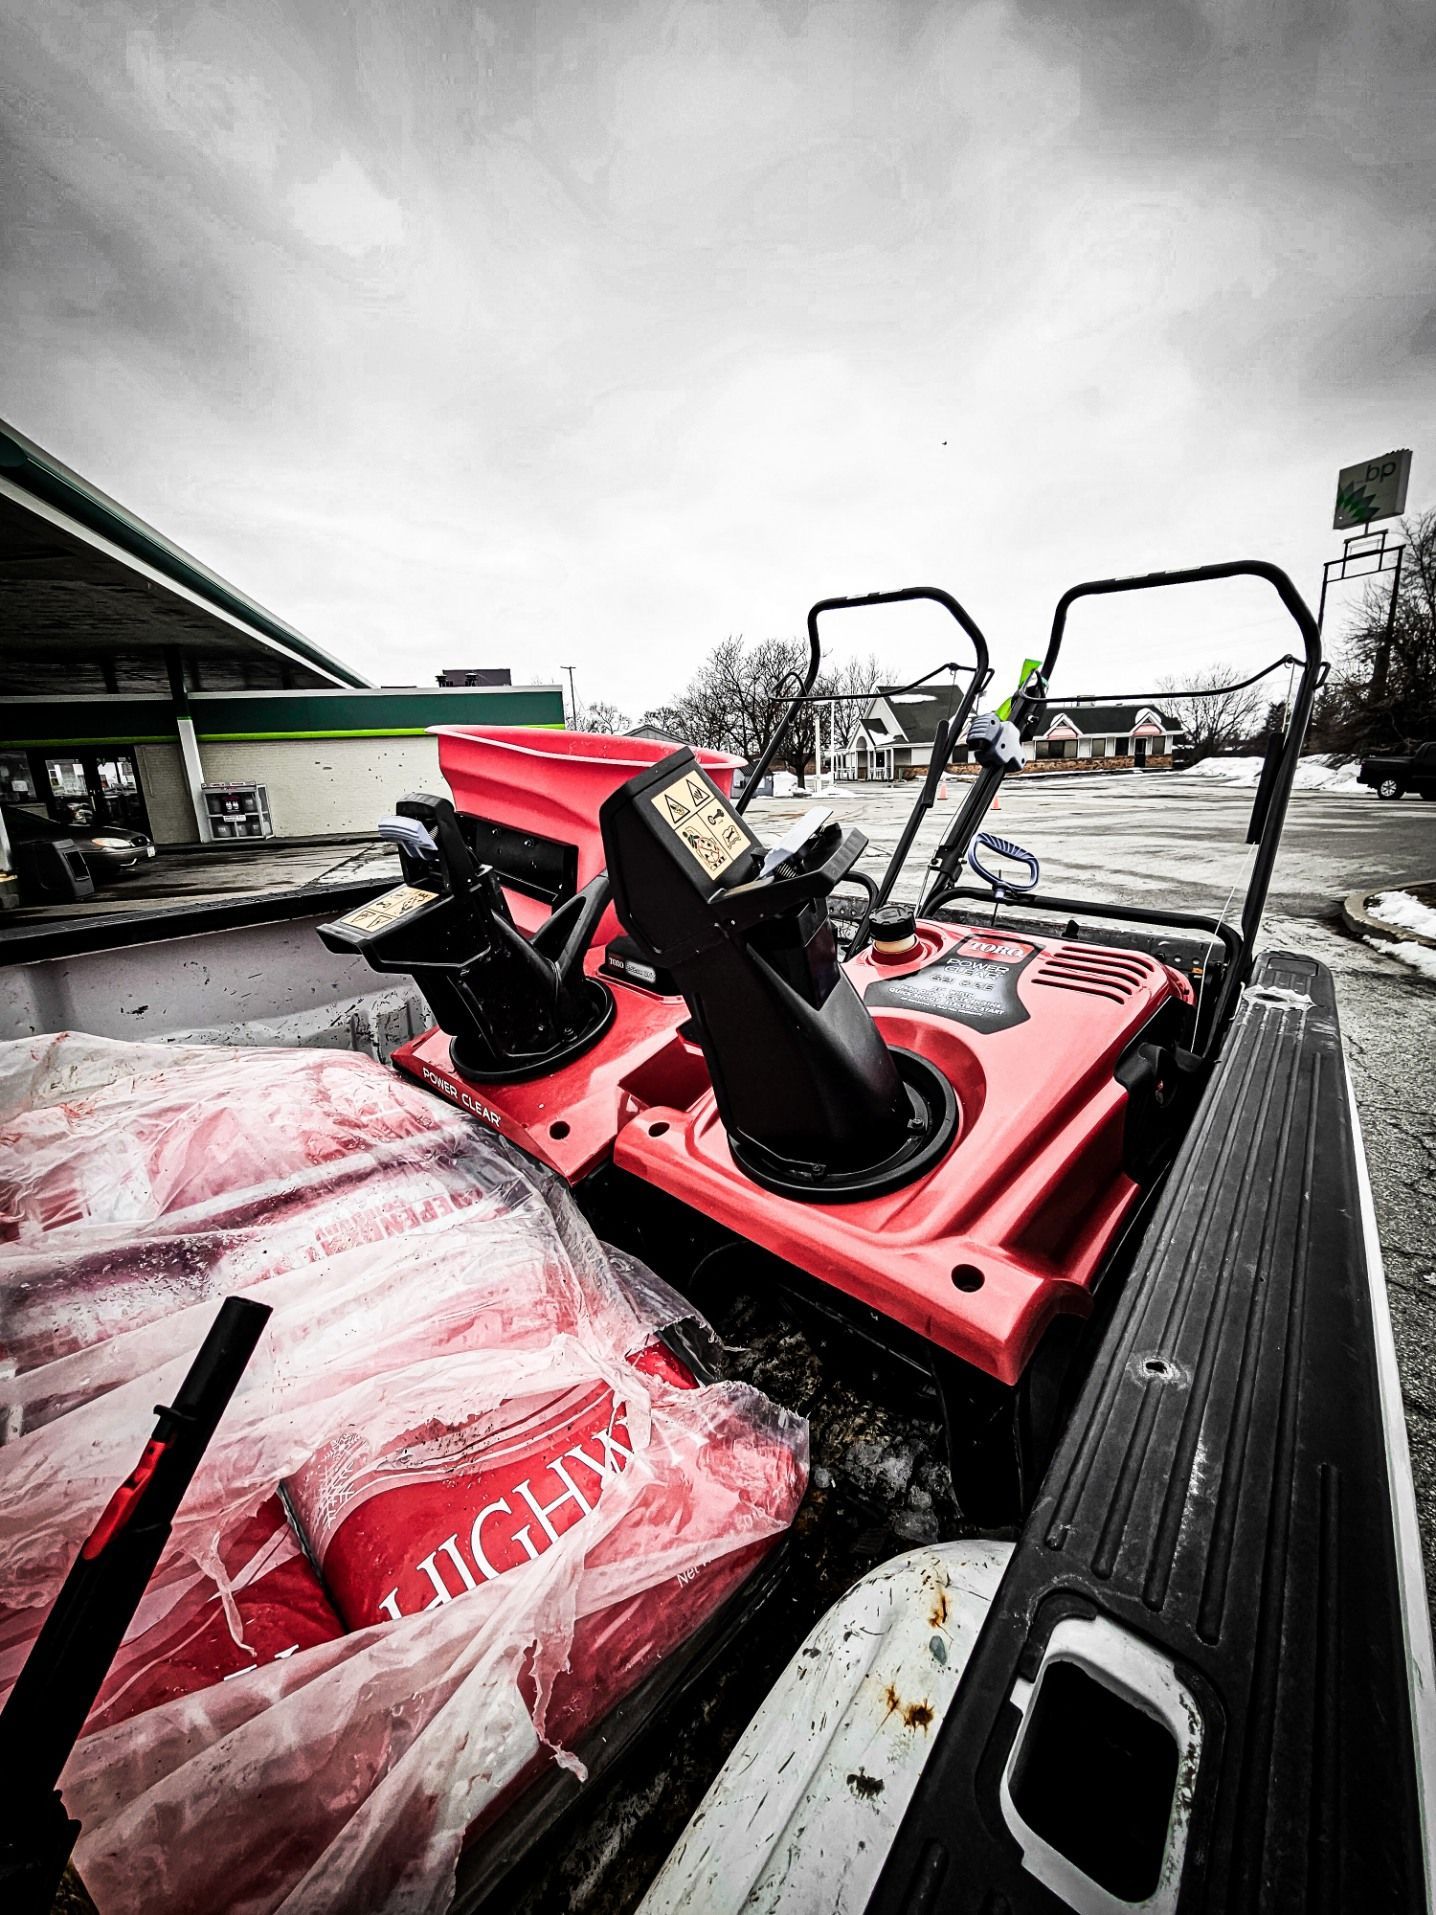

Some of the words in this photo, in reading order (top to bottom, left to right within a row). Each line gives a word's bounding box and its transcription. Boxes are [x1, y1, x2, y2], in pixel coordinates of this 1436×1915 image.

[1366, 462, 1396, 483] bp
[968, 941, 1024, 958] TORO
[944, 965, 1000, 981] CLEAR
[946, 958, 1010, 976] POWER
[422, 1066, 458, 1099] POWER
[461, 1092, 501, 1127] CLEAR
